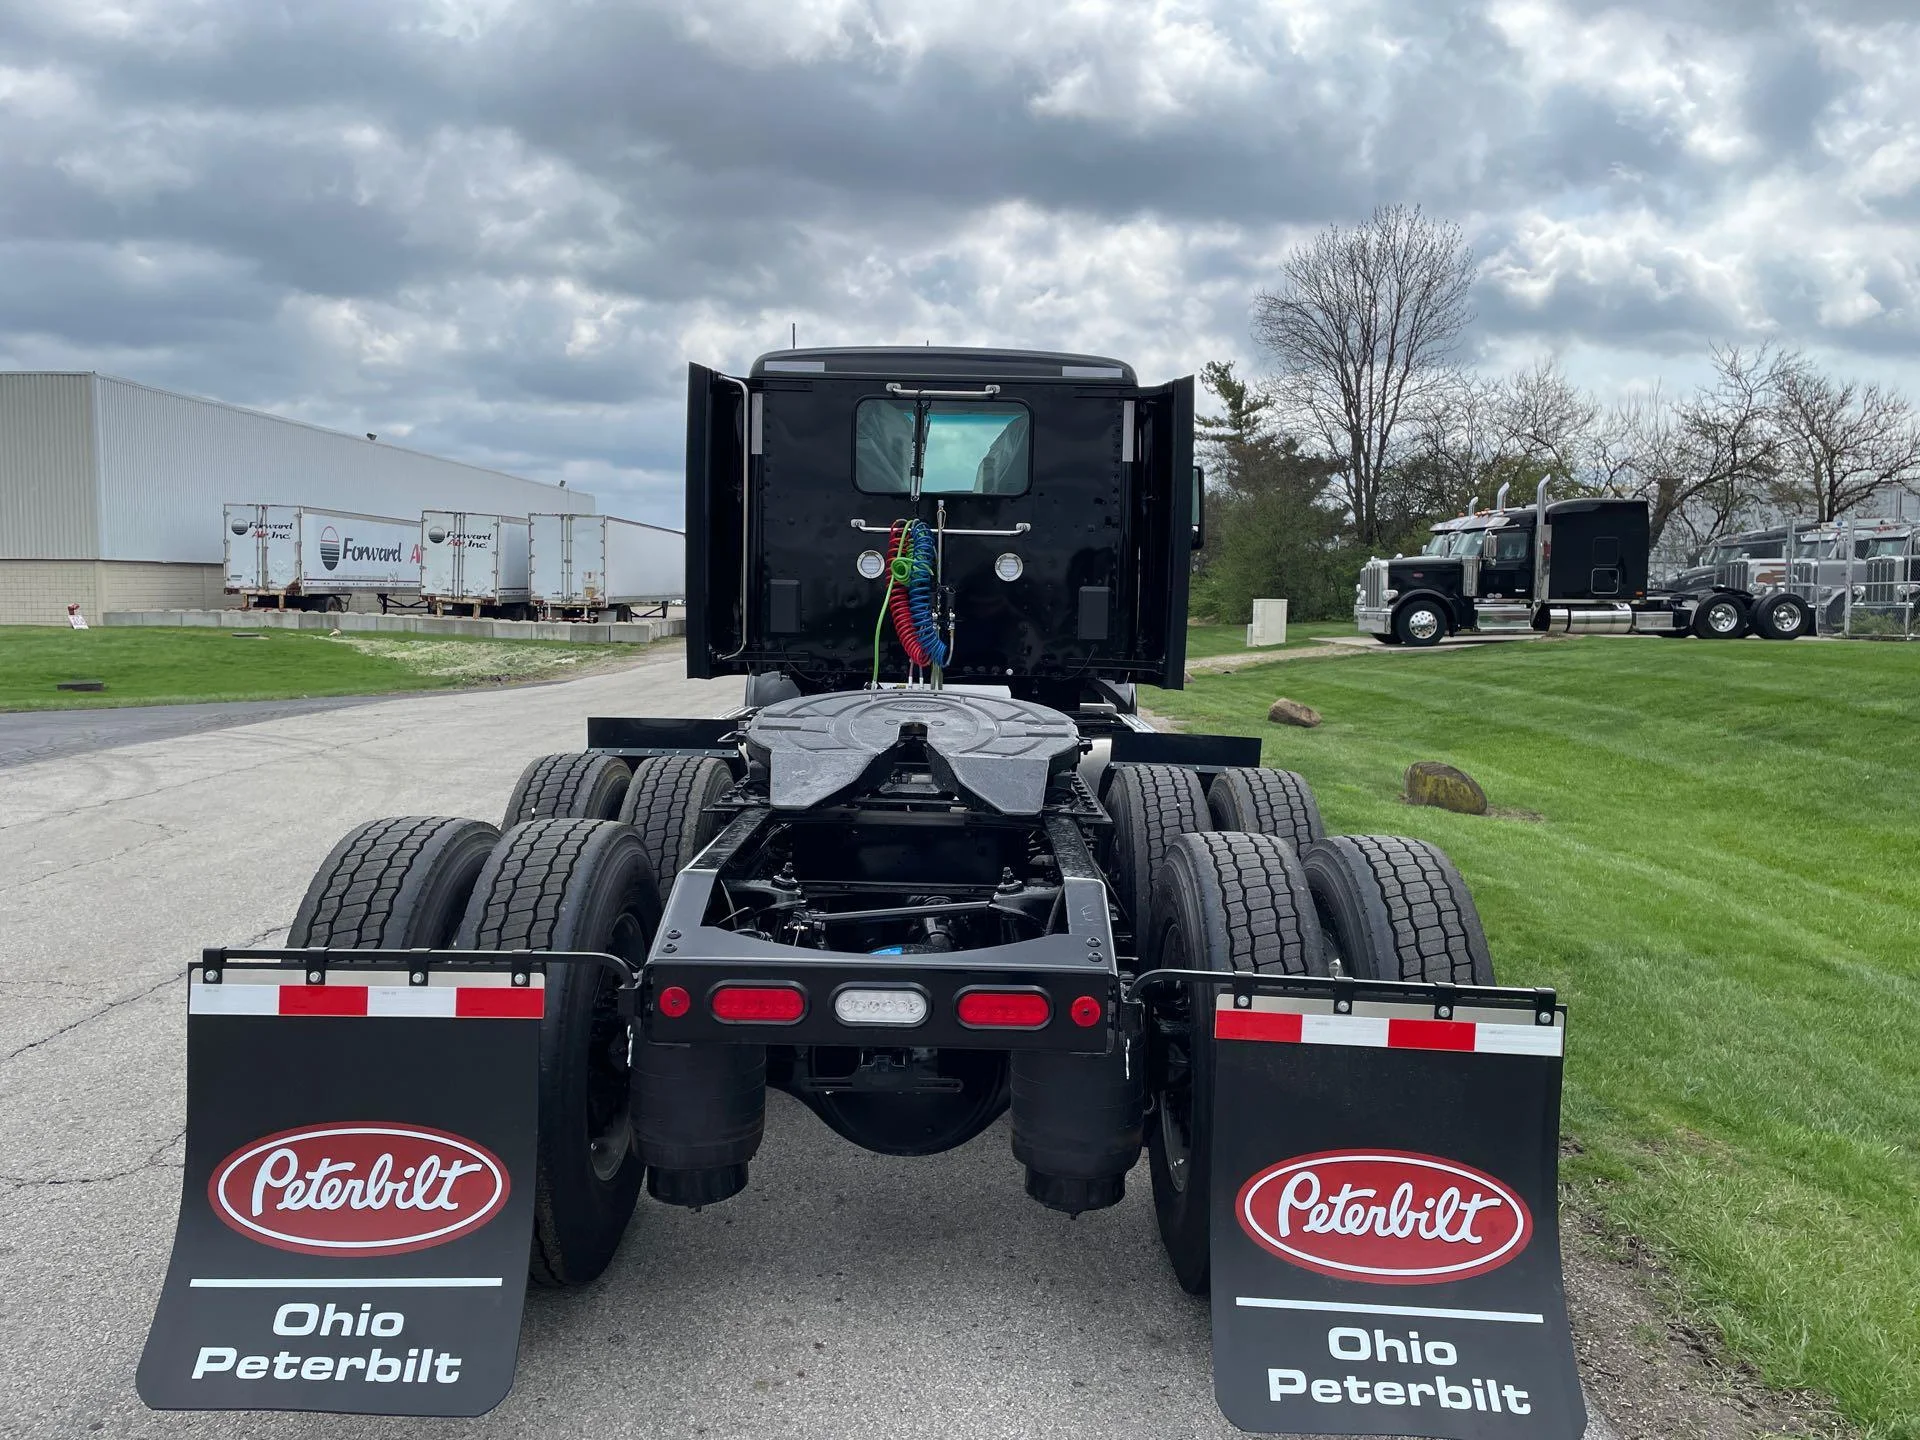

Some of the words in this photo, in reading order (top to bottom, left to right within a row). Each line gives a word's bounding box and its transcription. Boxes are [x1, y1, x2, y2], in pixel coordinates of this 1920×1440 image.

[248, 521, 293, 530] Forward
[446, 531, 492, 541] Forward
[342, 537, 402, 562] Forward
[251, 1148, 483, 1217] Peterbilt
[1278, 1171, 1502, 1244] Peterbilt
[272, 1302, 405, 1337] Ohio
[191, 1346, 462, 1384] Peterbilt
[1328, 1326, 1458, 1366] Ohio
[1267, 1368, 1532, 1415] Peterbilt
